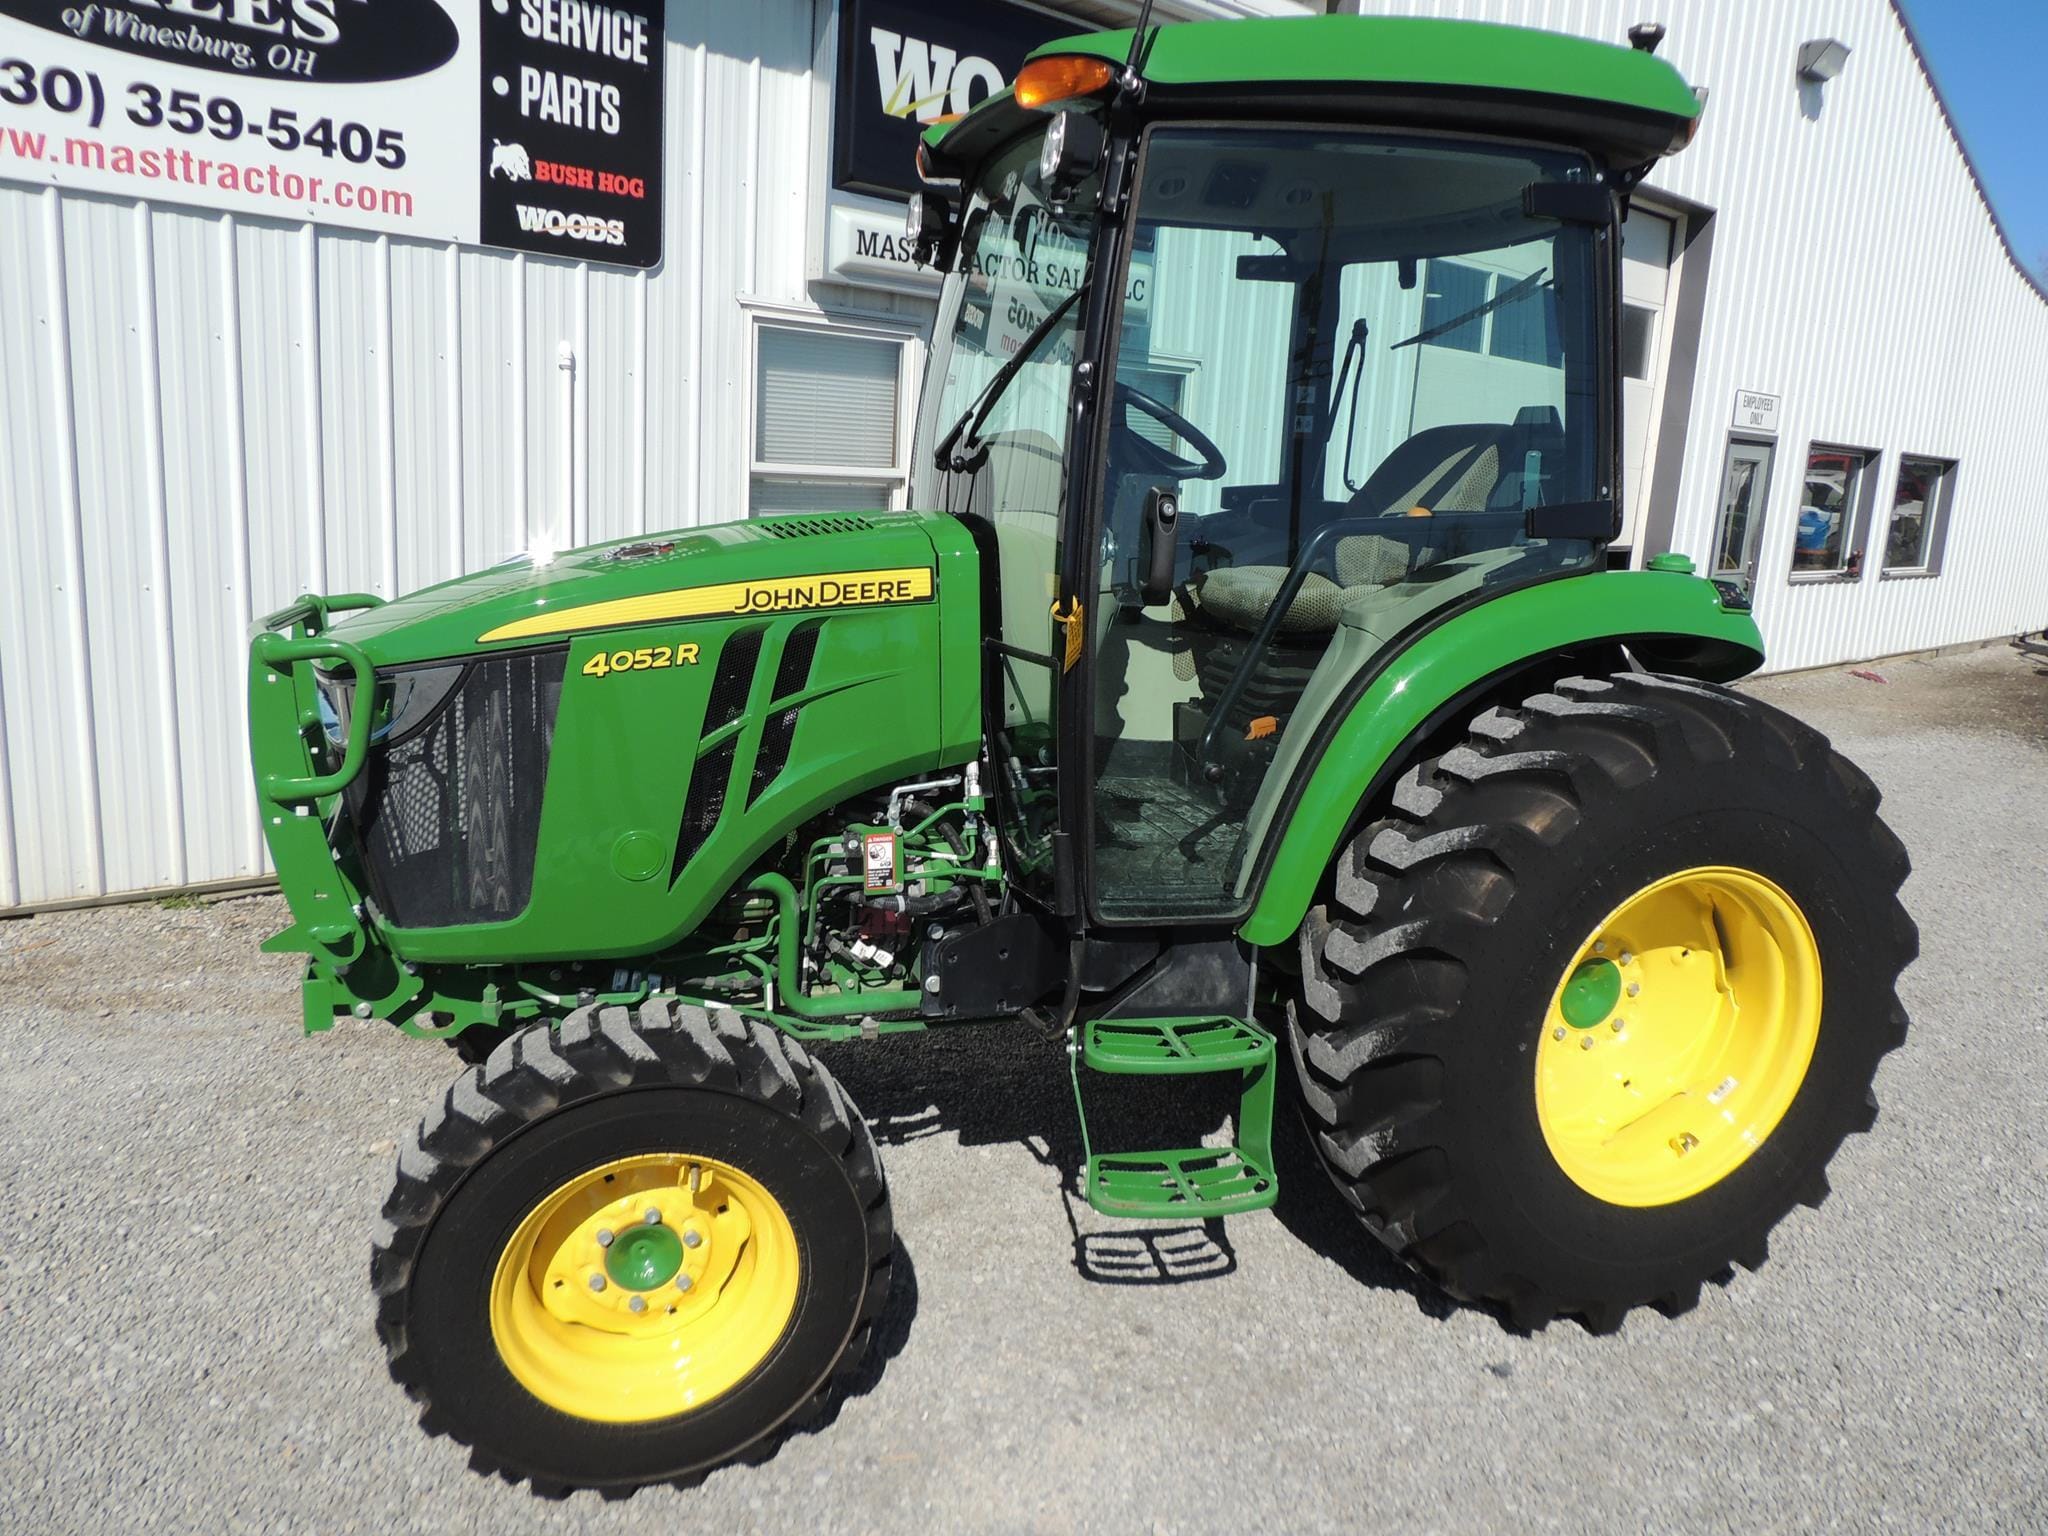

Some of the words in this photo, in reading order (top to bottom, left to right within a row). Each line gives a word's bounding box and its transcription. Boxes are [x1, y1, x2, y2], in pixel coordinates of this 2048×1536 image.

[61, 3, 100, 38] of
[103, 7, 257, 69] Winesburg,
[267, 44, 318, 76] OH
[520, 0, 648, 65] SERVICE
[125, 82, 407, 169] 359-5405
[520, 65, 621, 135] PARTS
[0, 126, 414, 217] w.masttractor.com
[535, 159, 594, 189] BUSH
[598, 171, 645, 198] HOG
[516, 204, 626, 246] WOODS
[856, 229, 910, 263] MAS
[968, 250, 1040, 285] ACTOR
[1045, 263, 1082, 292] SAL
[1743, 394, 1773, 411] EMPLOYEES
[1750, 411, 1764, 425] ONLY
[734, 586, 813, 611] JOHN
[819, 580, 911, 603] DEERE
